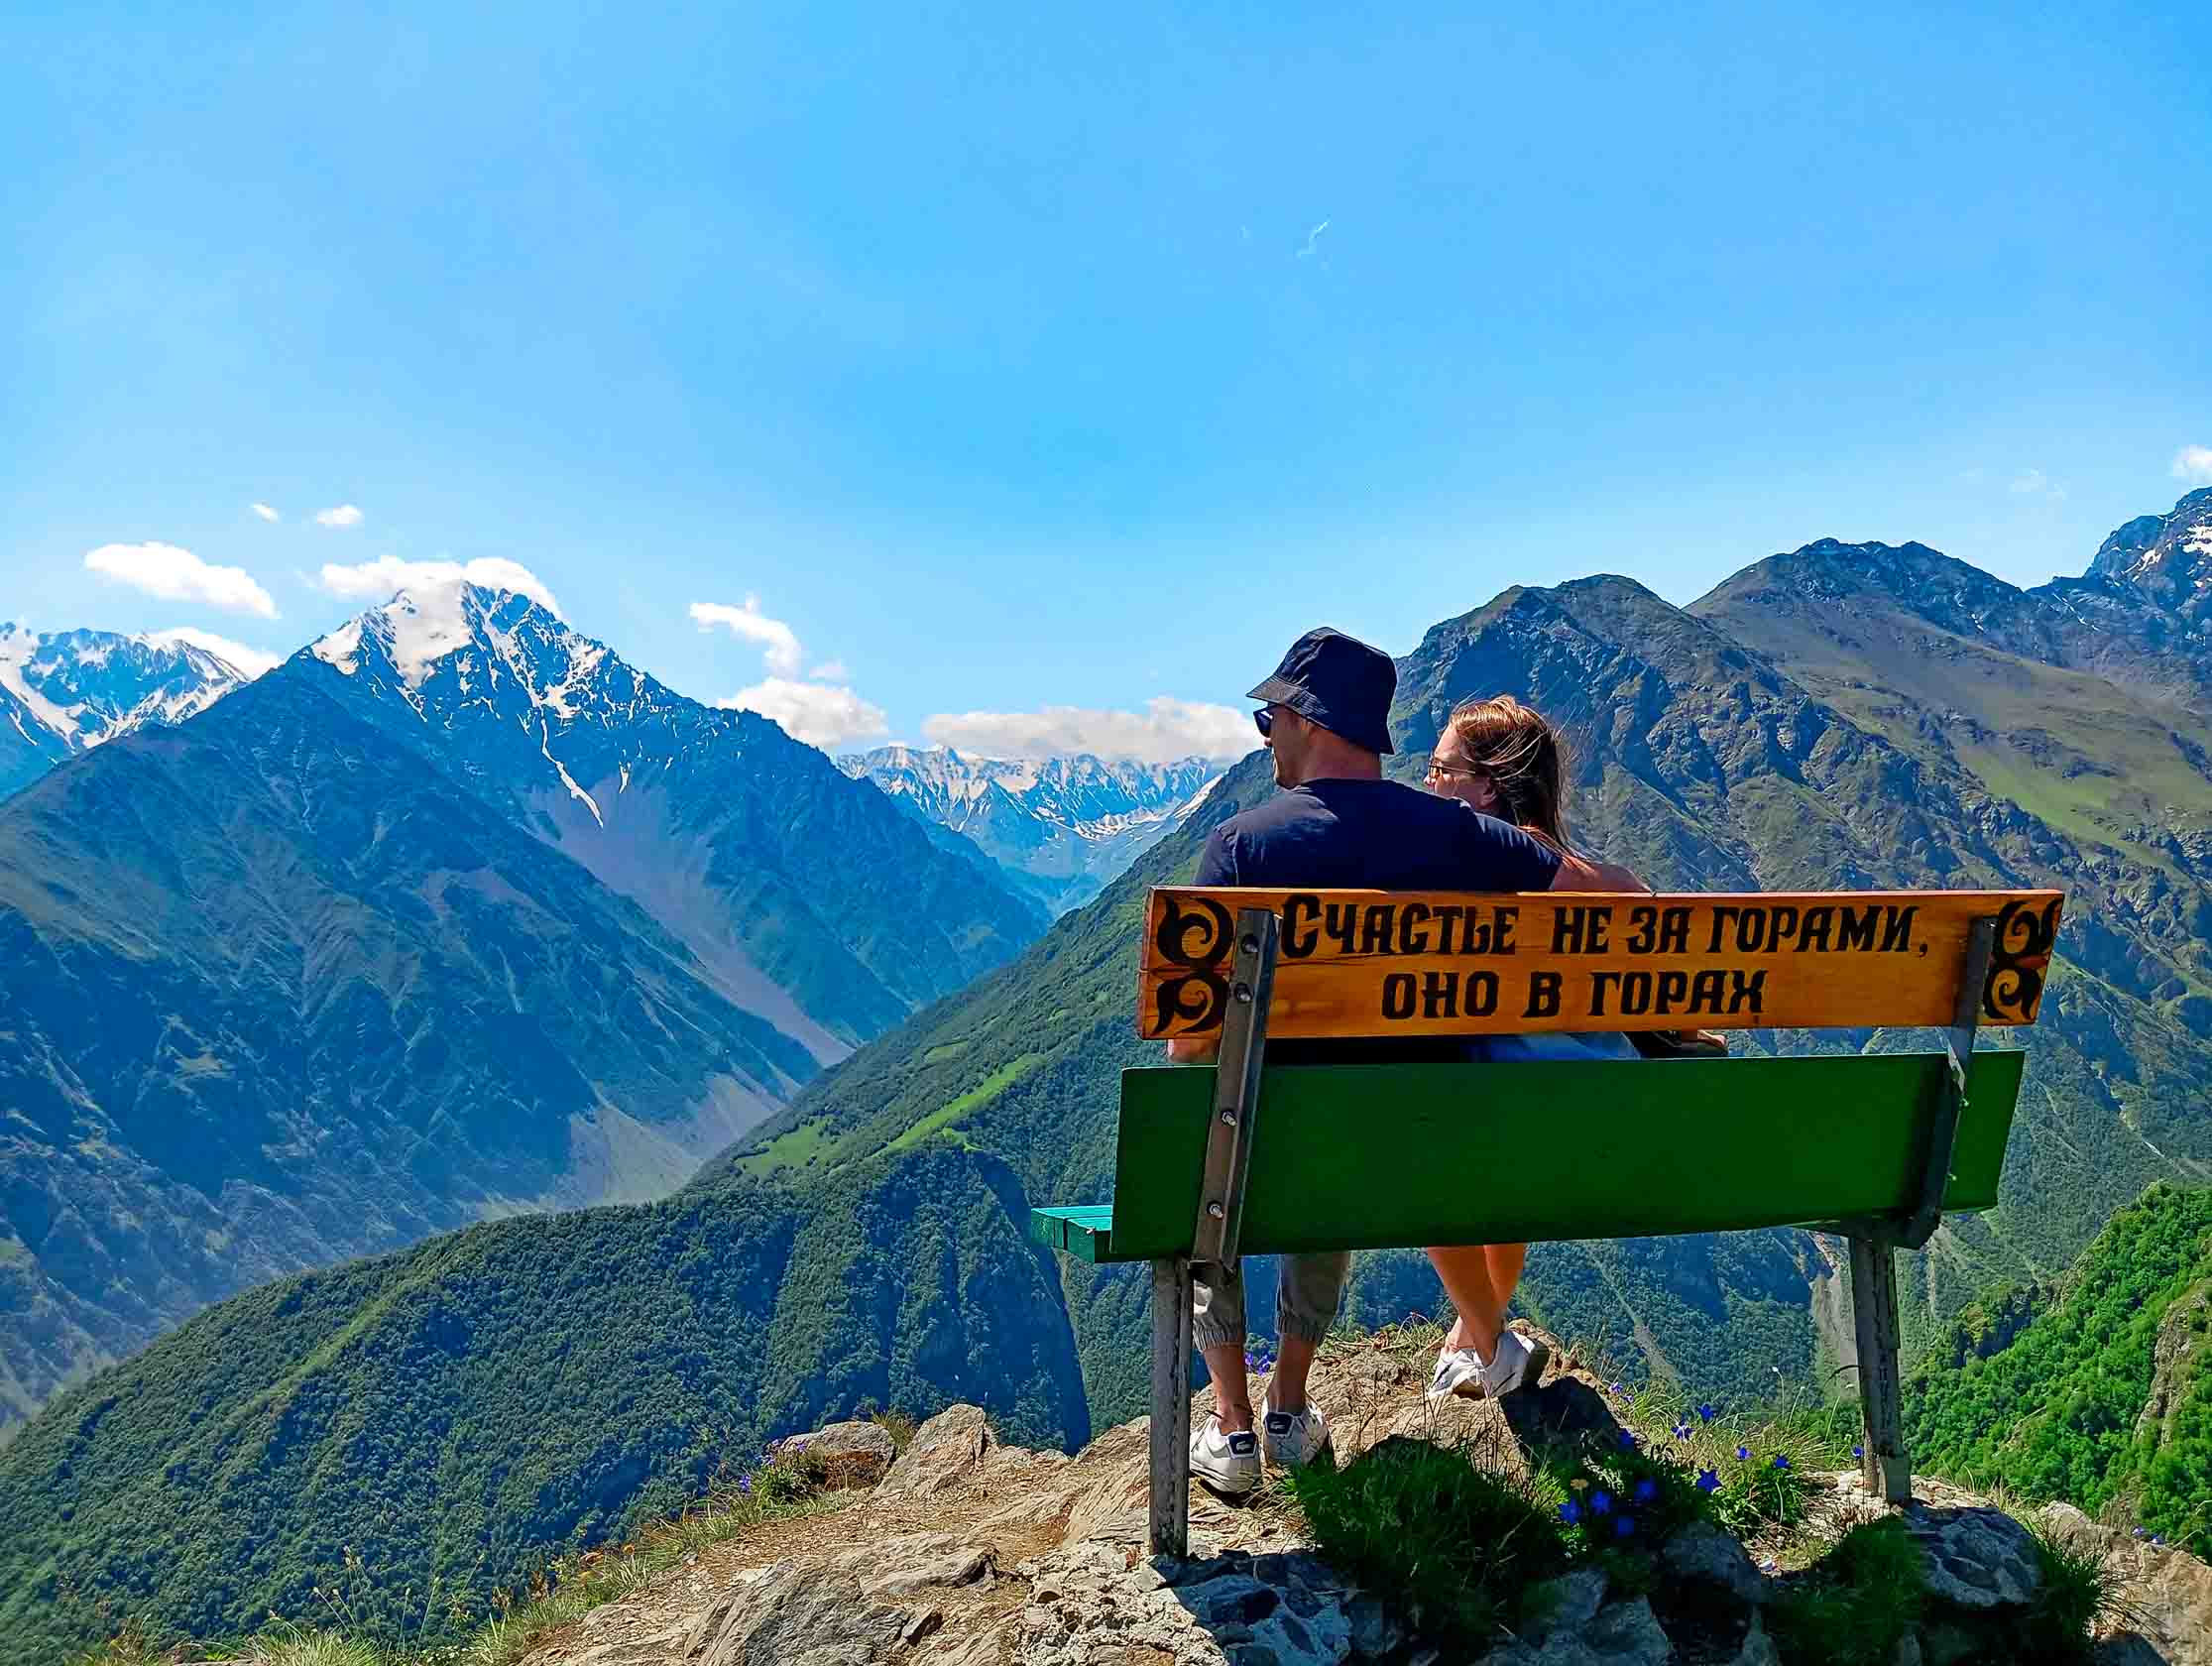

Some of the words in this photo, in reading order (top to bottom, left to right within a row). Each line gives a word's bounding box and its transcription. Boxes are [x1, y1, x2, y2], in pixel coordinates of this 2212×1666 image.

[1280, 894, 1520, 959] СЧАСТЬЕ
[1548, 905, 1613, 954] НЕ
[1625, 905, 1693, 954] ЗА
[1705, 904, 1928, 959] ГОРАМИ,
[1381, 971, 1500, 1020] ОНО
[1521, 972, 1564, 1018] В
[1586, 969, 1769, 1016] ГОРАХ
